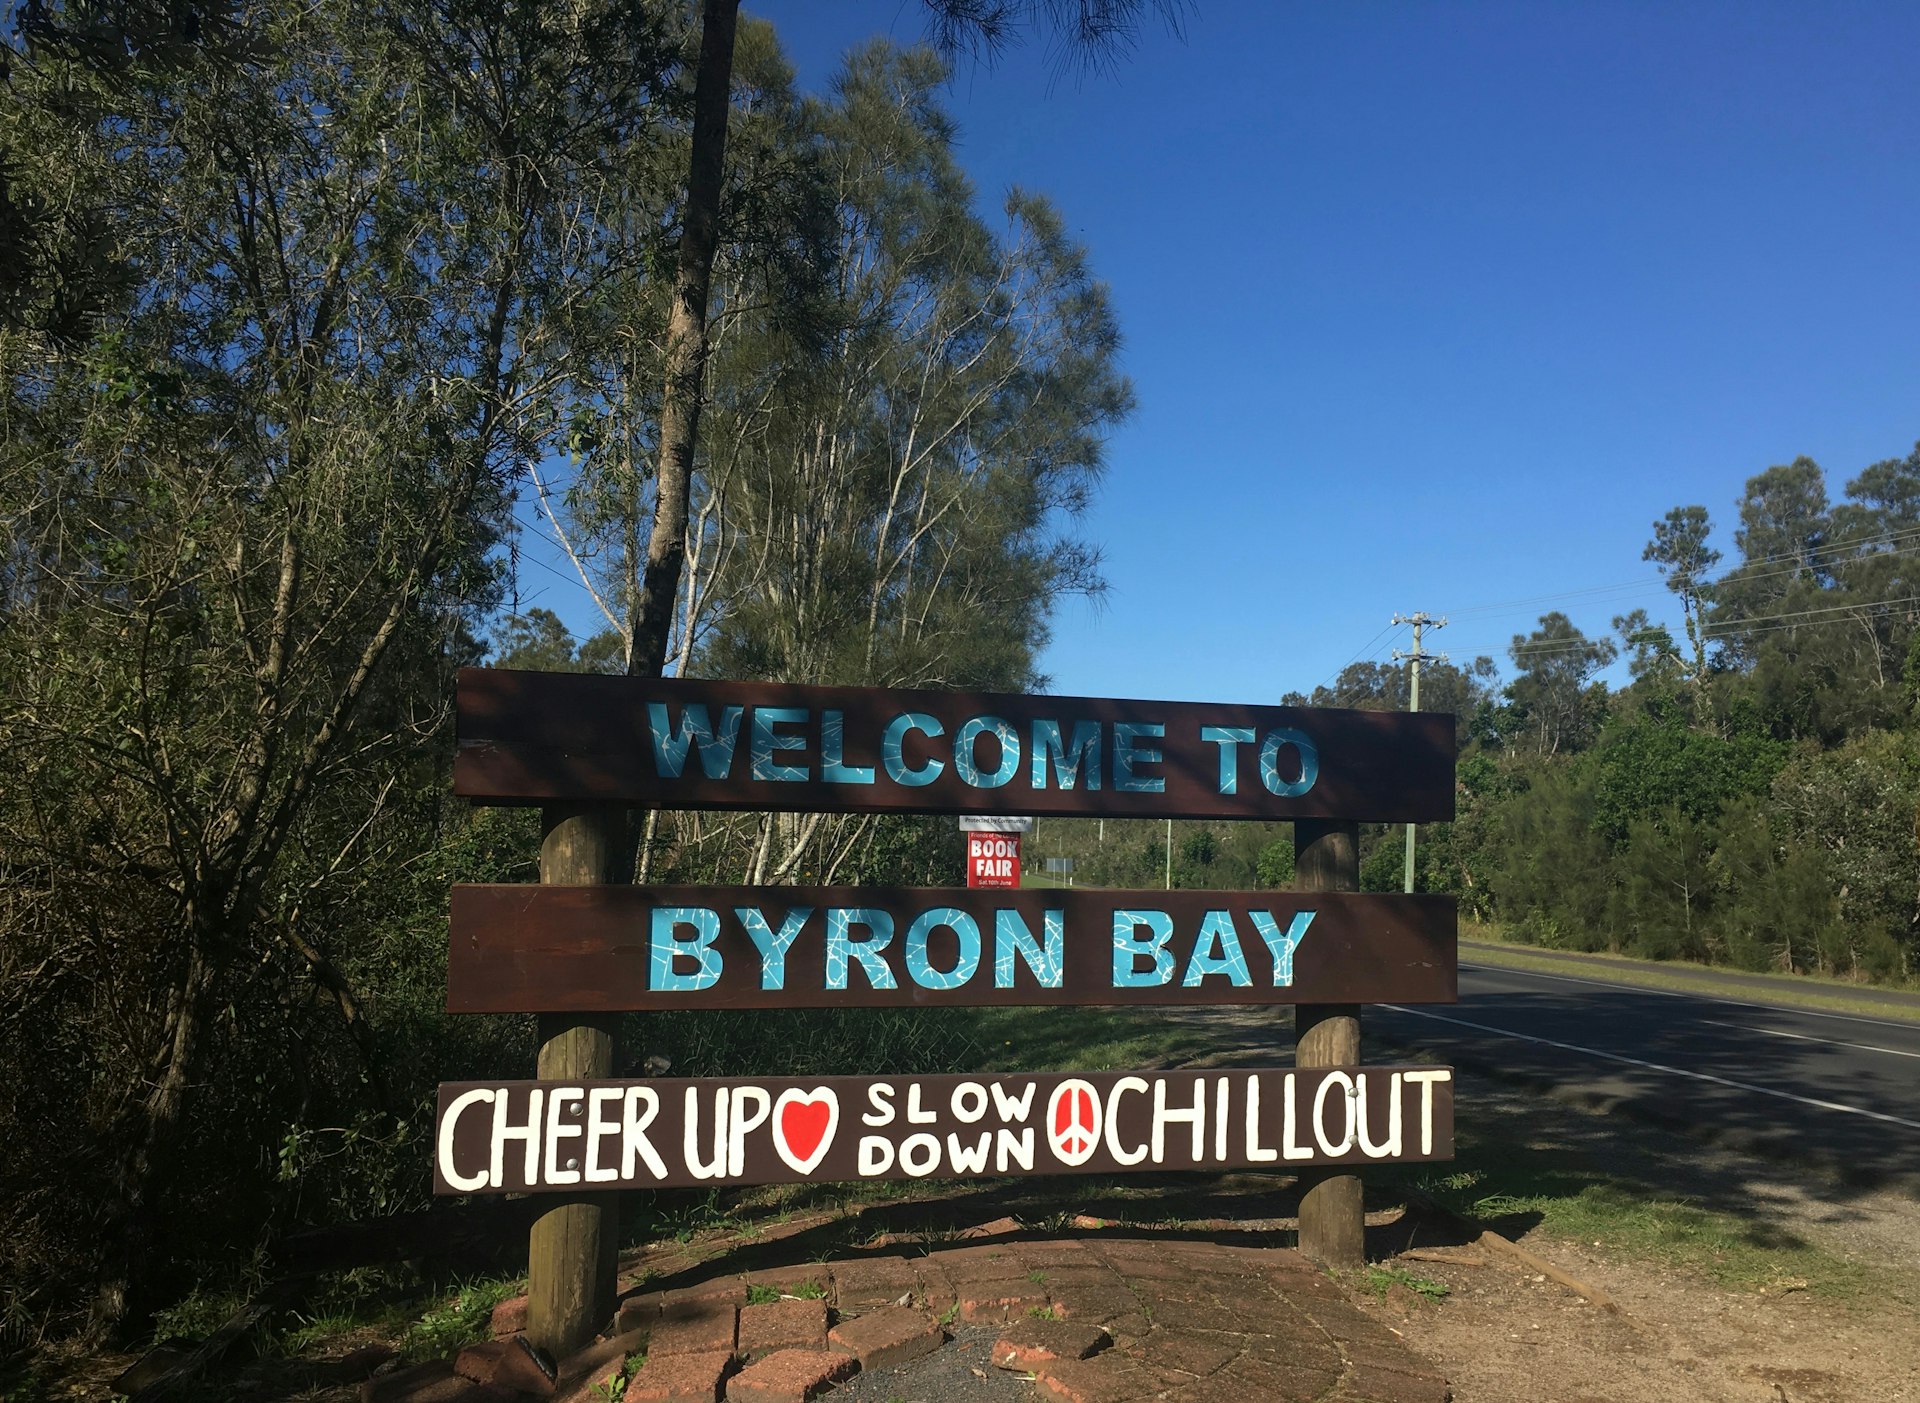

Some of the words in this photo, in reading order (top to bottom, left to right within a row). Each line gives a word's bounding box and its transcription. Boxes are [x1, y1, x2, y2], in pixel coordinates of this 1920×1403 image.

[647, 702, 1166, 792] WELCOME
[1201, 725, 1319, 797] TO
[991, 817, 997, 825] by
[997, 817, 1027, 825] Community
[971, 840, 1018, 858] BOOK
[976, 859, 1013, 877] FAIR
[648, 908, 1064, 991] BYRON
[1112, 909, 1317, 987] BAY
[861, 1082, 1037, 1127] SLOW
[438, 1086, 669, 1192] CHEER
[684, 1086, 771, 1179] UP
[857, 1127, 1035, 1177] DOWN
